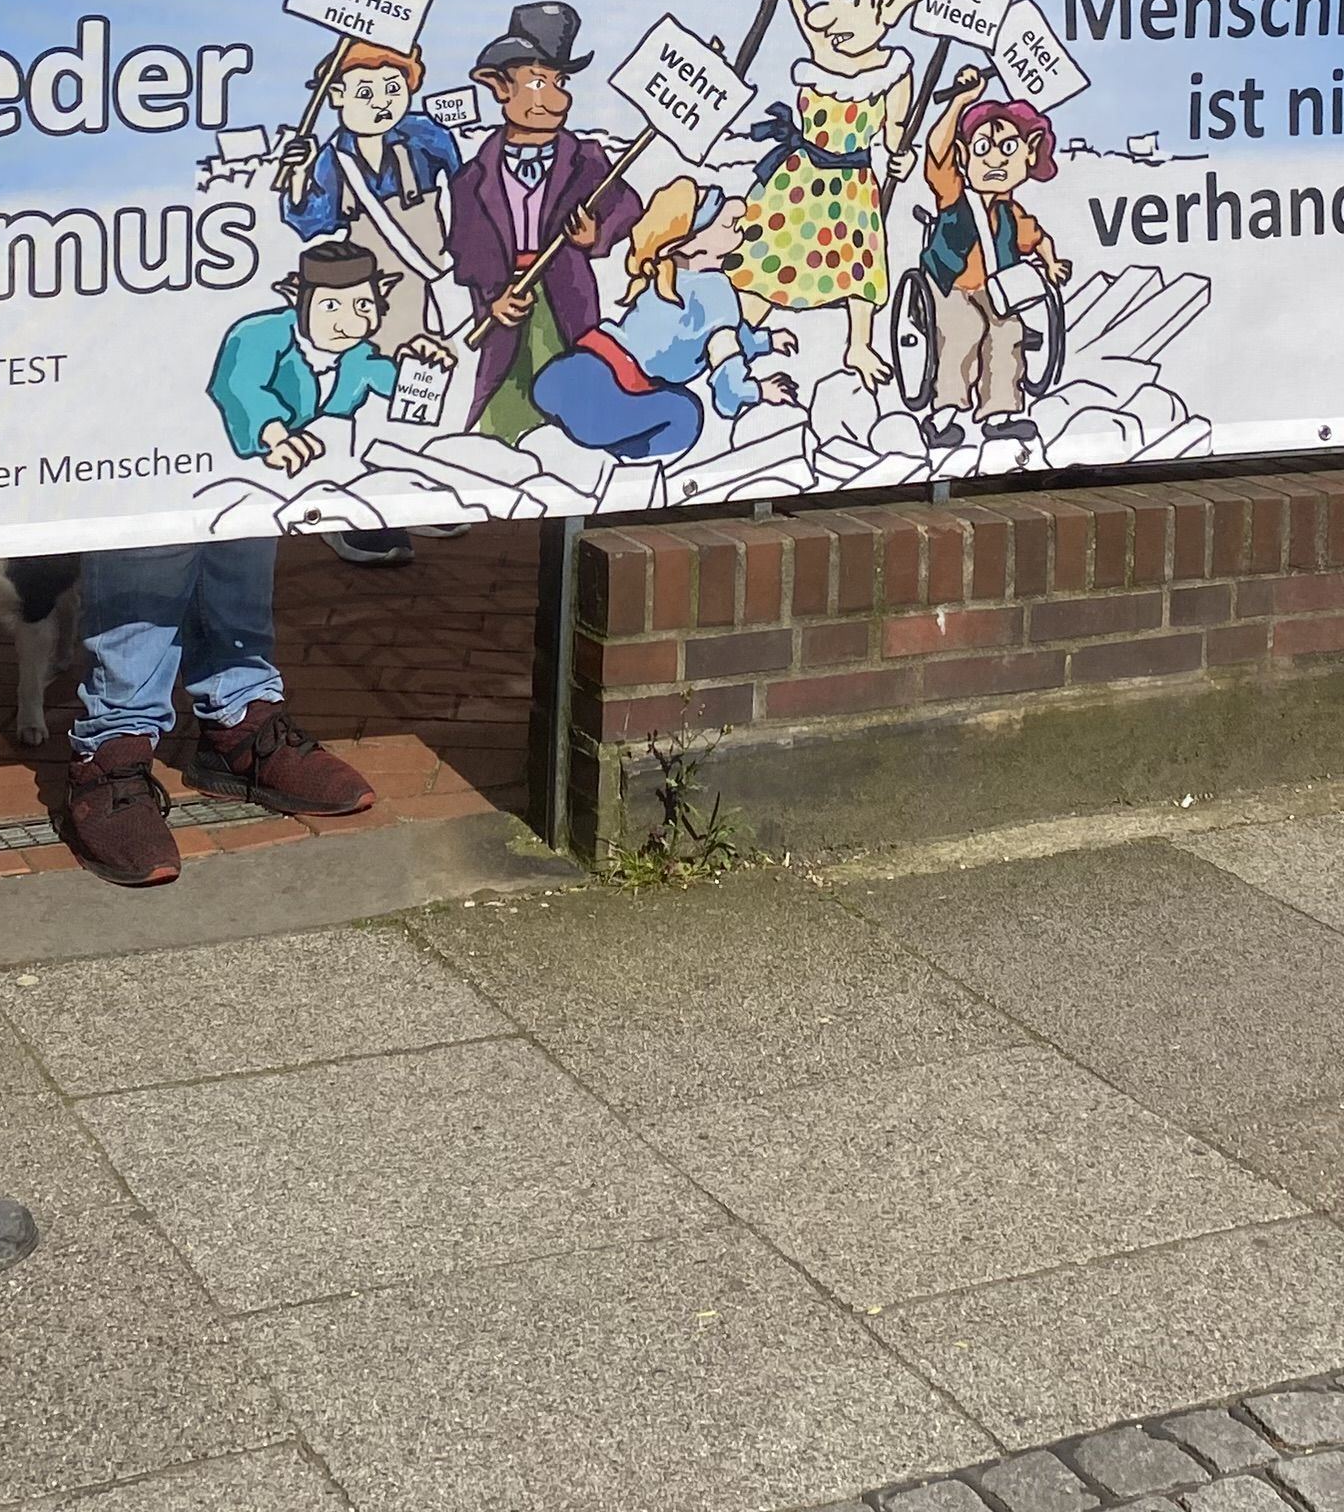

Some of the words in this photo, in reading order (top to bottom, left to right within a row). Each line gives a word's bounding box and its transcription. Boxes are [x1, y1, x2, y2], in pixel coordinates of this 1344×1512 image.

[324, 6, 375, 35] nicht
[1002, 42, 1045, 95] hAfD
[1022, 30, 1060, 76] ekel-
[659, 43, 728, 111] wehrt
[434, 110, 467, 123] Nazis
[435, 98, 464, 113] Stop
[645, 72, 701, 131] Euch
[1189, 72, 1265, 141] ist
[398, 384, 441, 402] wieder
[413, 371, 433, 384] nie
[400, 398, 428, 422] T4
[40, 447, 213, 484] Menschen
